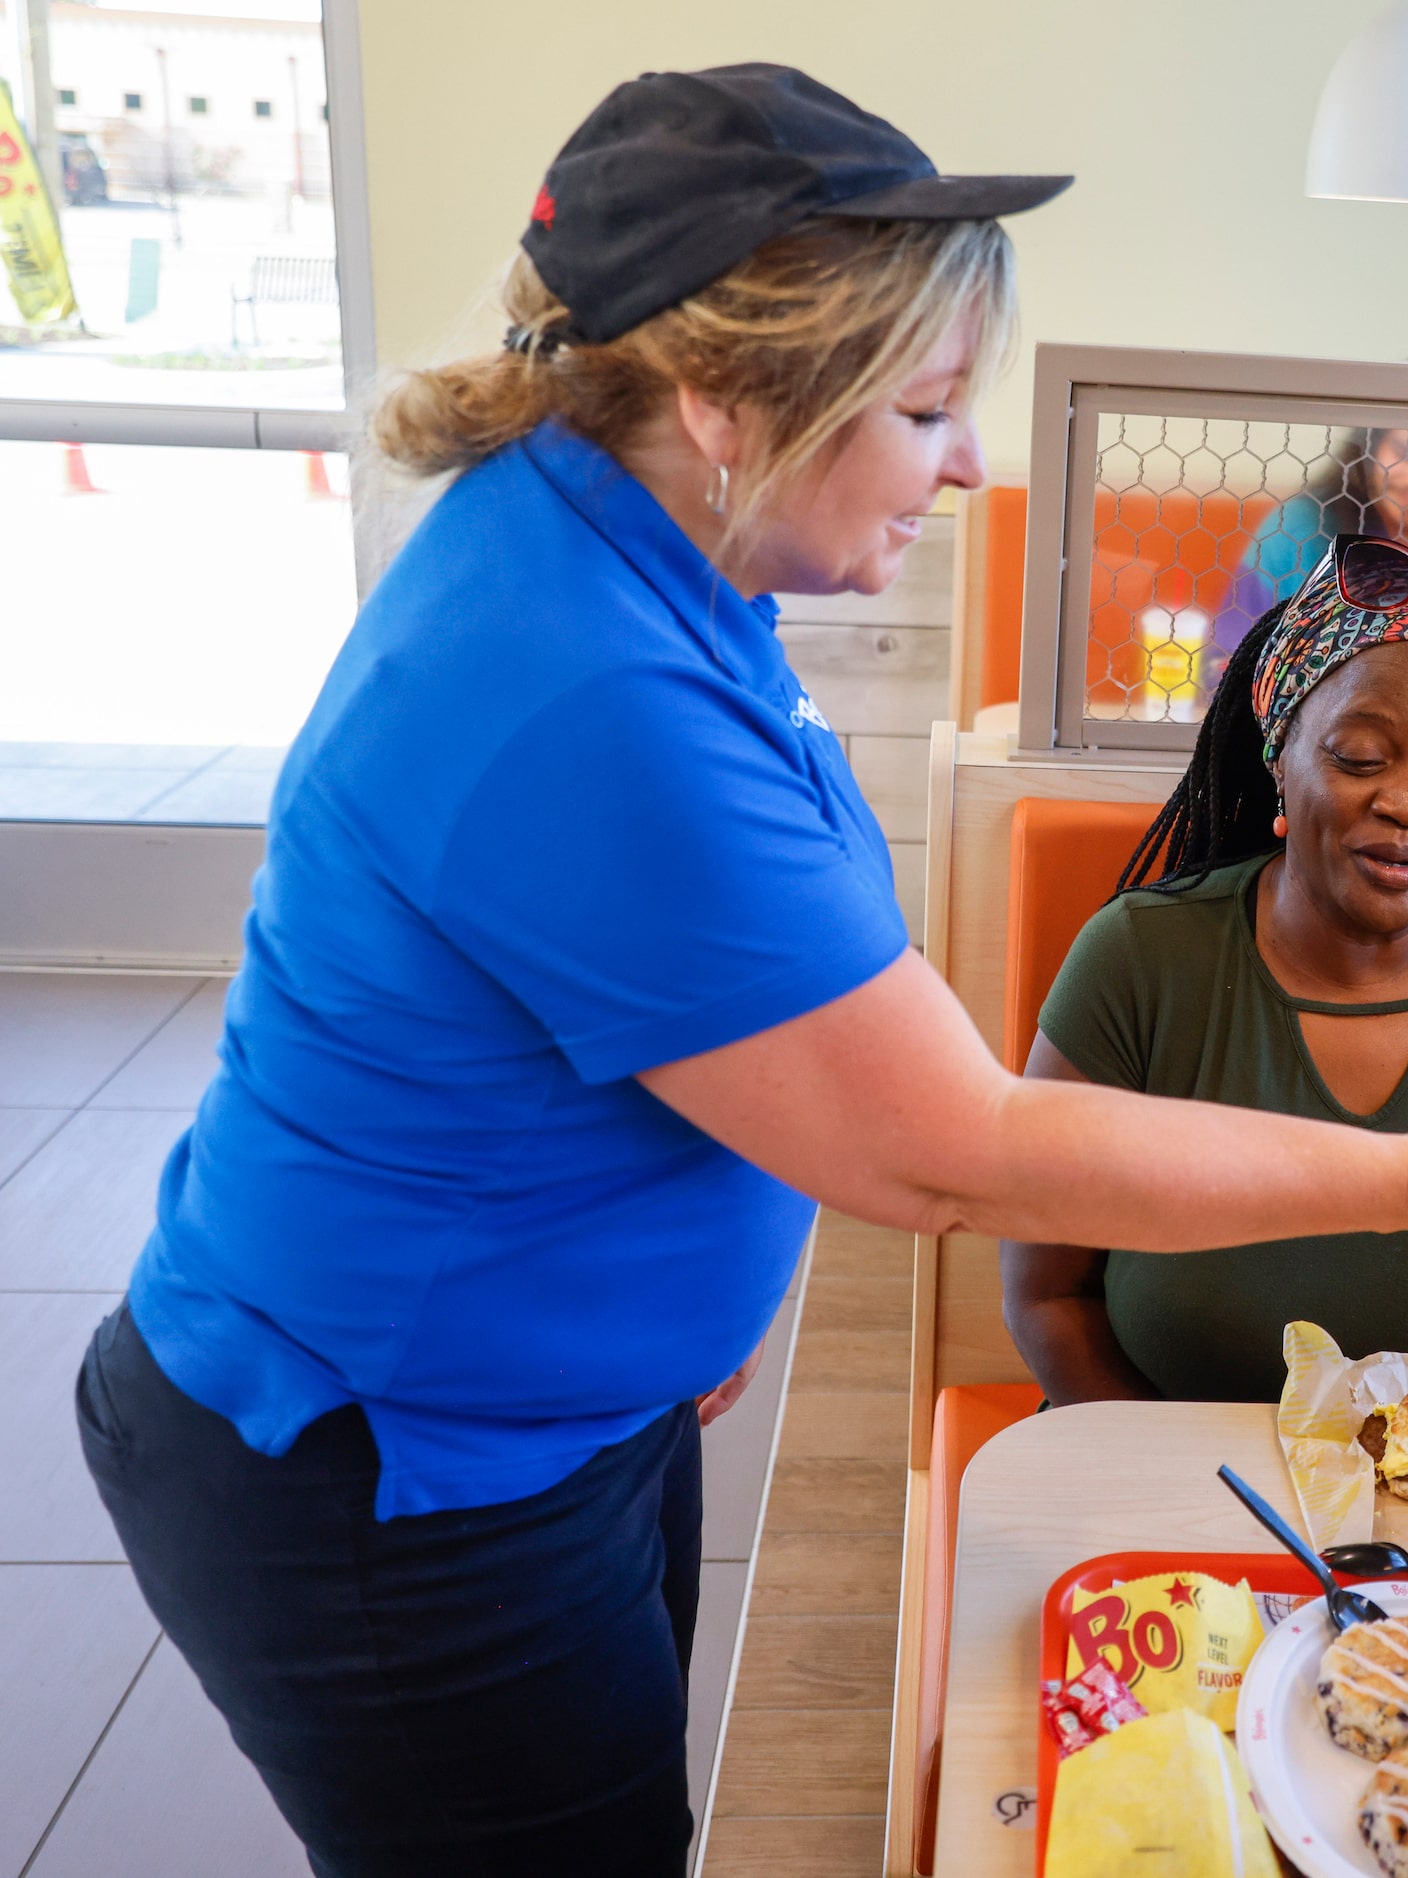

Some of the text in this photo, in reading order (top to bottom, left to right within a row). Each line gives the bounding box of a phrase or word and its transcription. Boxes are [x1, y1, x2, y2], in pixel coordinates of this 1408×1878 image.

[1208, 1633, 1229, 1649] NEXT
[1207, 1648, 1229, 1666] LEVEL
[1197, 1669, 1243, 1688] FLAVOR
